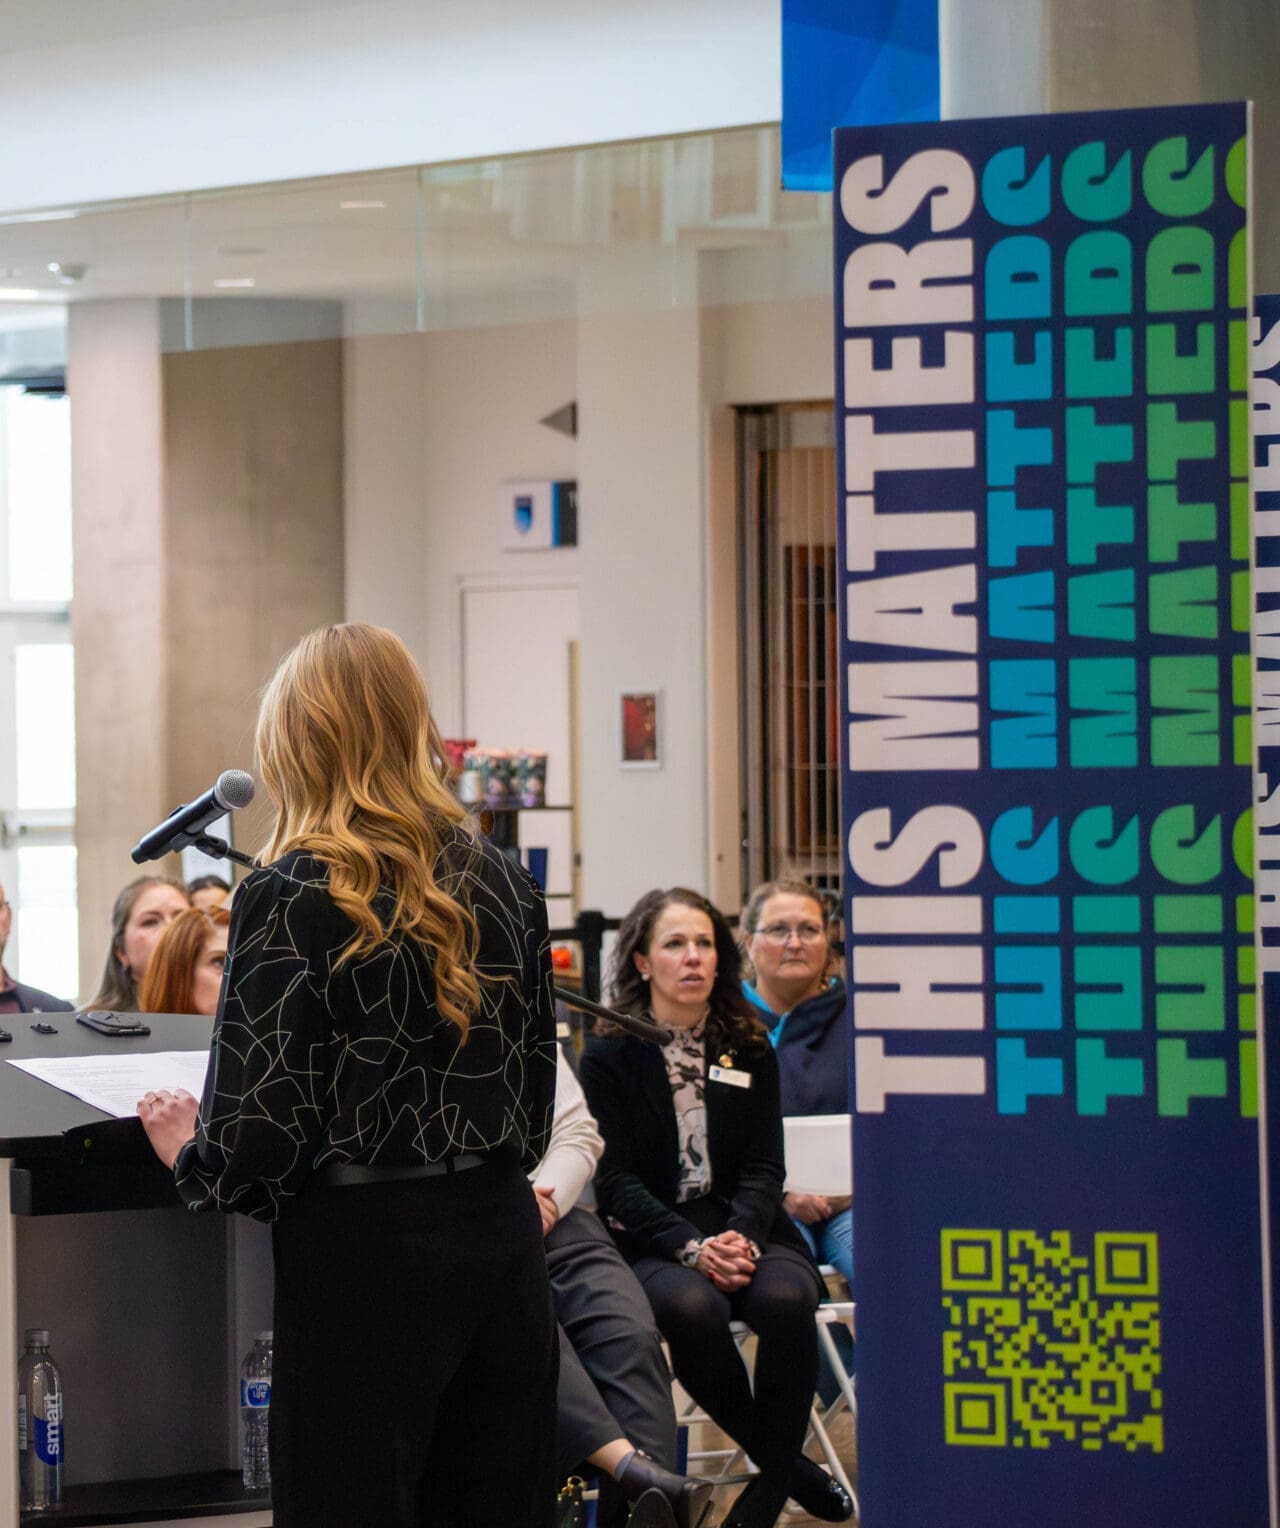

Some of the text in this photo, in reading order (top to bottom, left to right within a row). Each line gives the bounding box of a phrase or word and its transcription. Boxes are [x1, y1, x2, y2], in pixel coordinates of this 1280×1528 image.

[840, 148, 986, 1114] THIS MATTERS
[43, 1392, 60, 1456] smart
